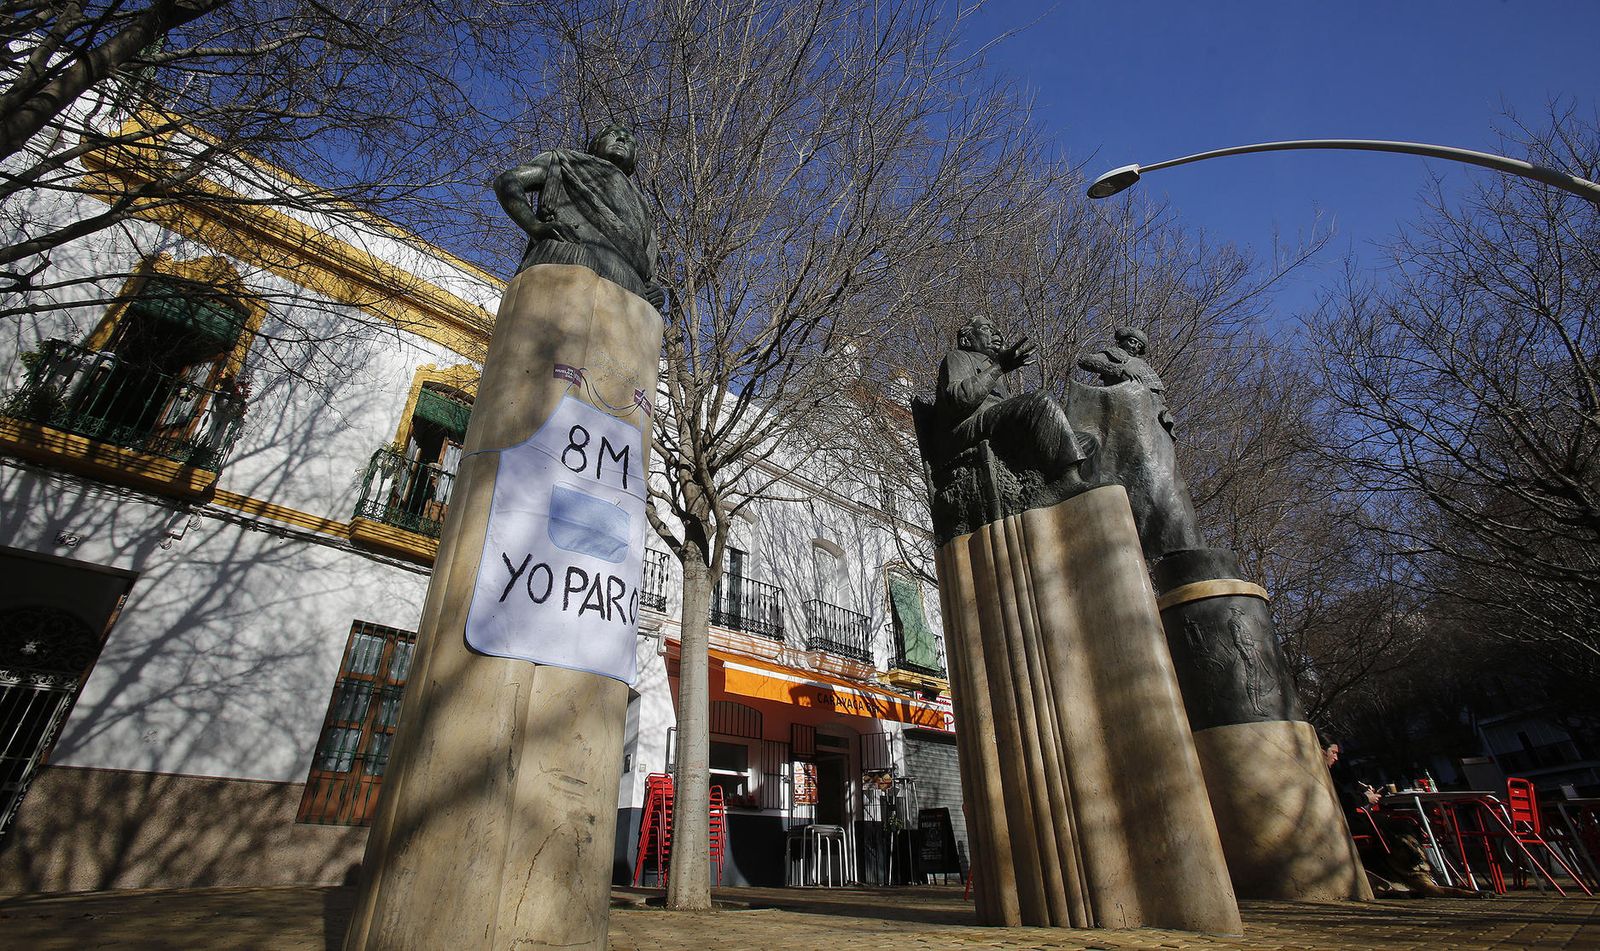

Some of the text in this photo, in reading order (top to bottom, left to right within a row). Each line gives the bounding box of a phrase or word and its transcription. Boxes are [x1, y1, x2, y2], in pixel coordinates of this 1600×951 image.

[561, 424, 630, 490] 8M
[499, 552, 639, 626] YO PARO
